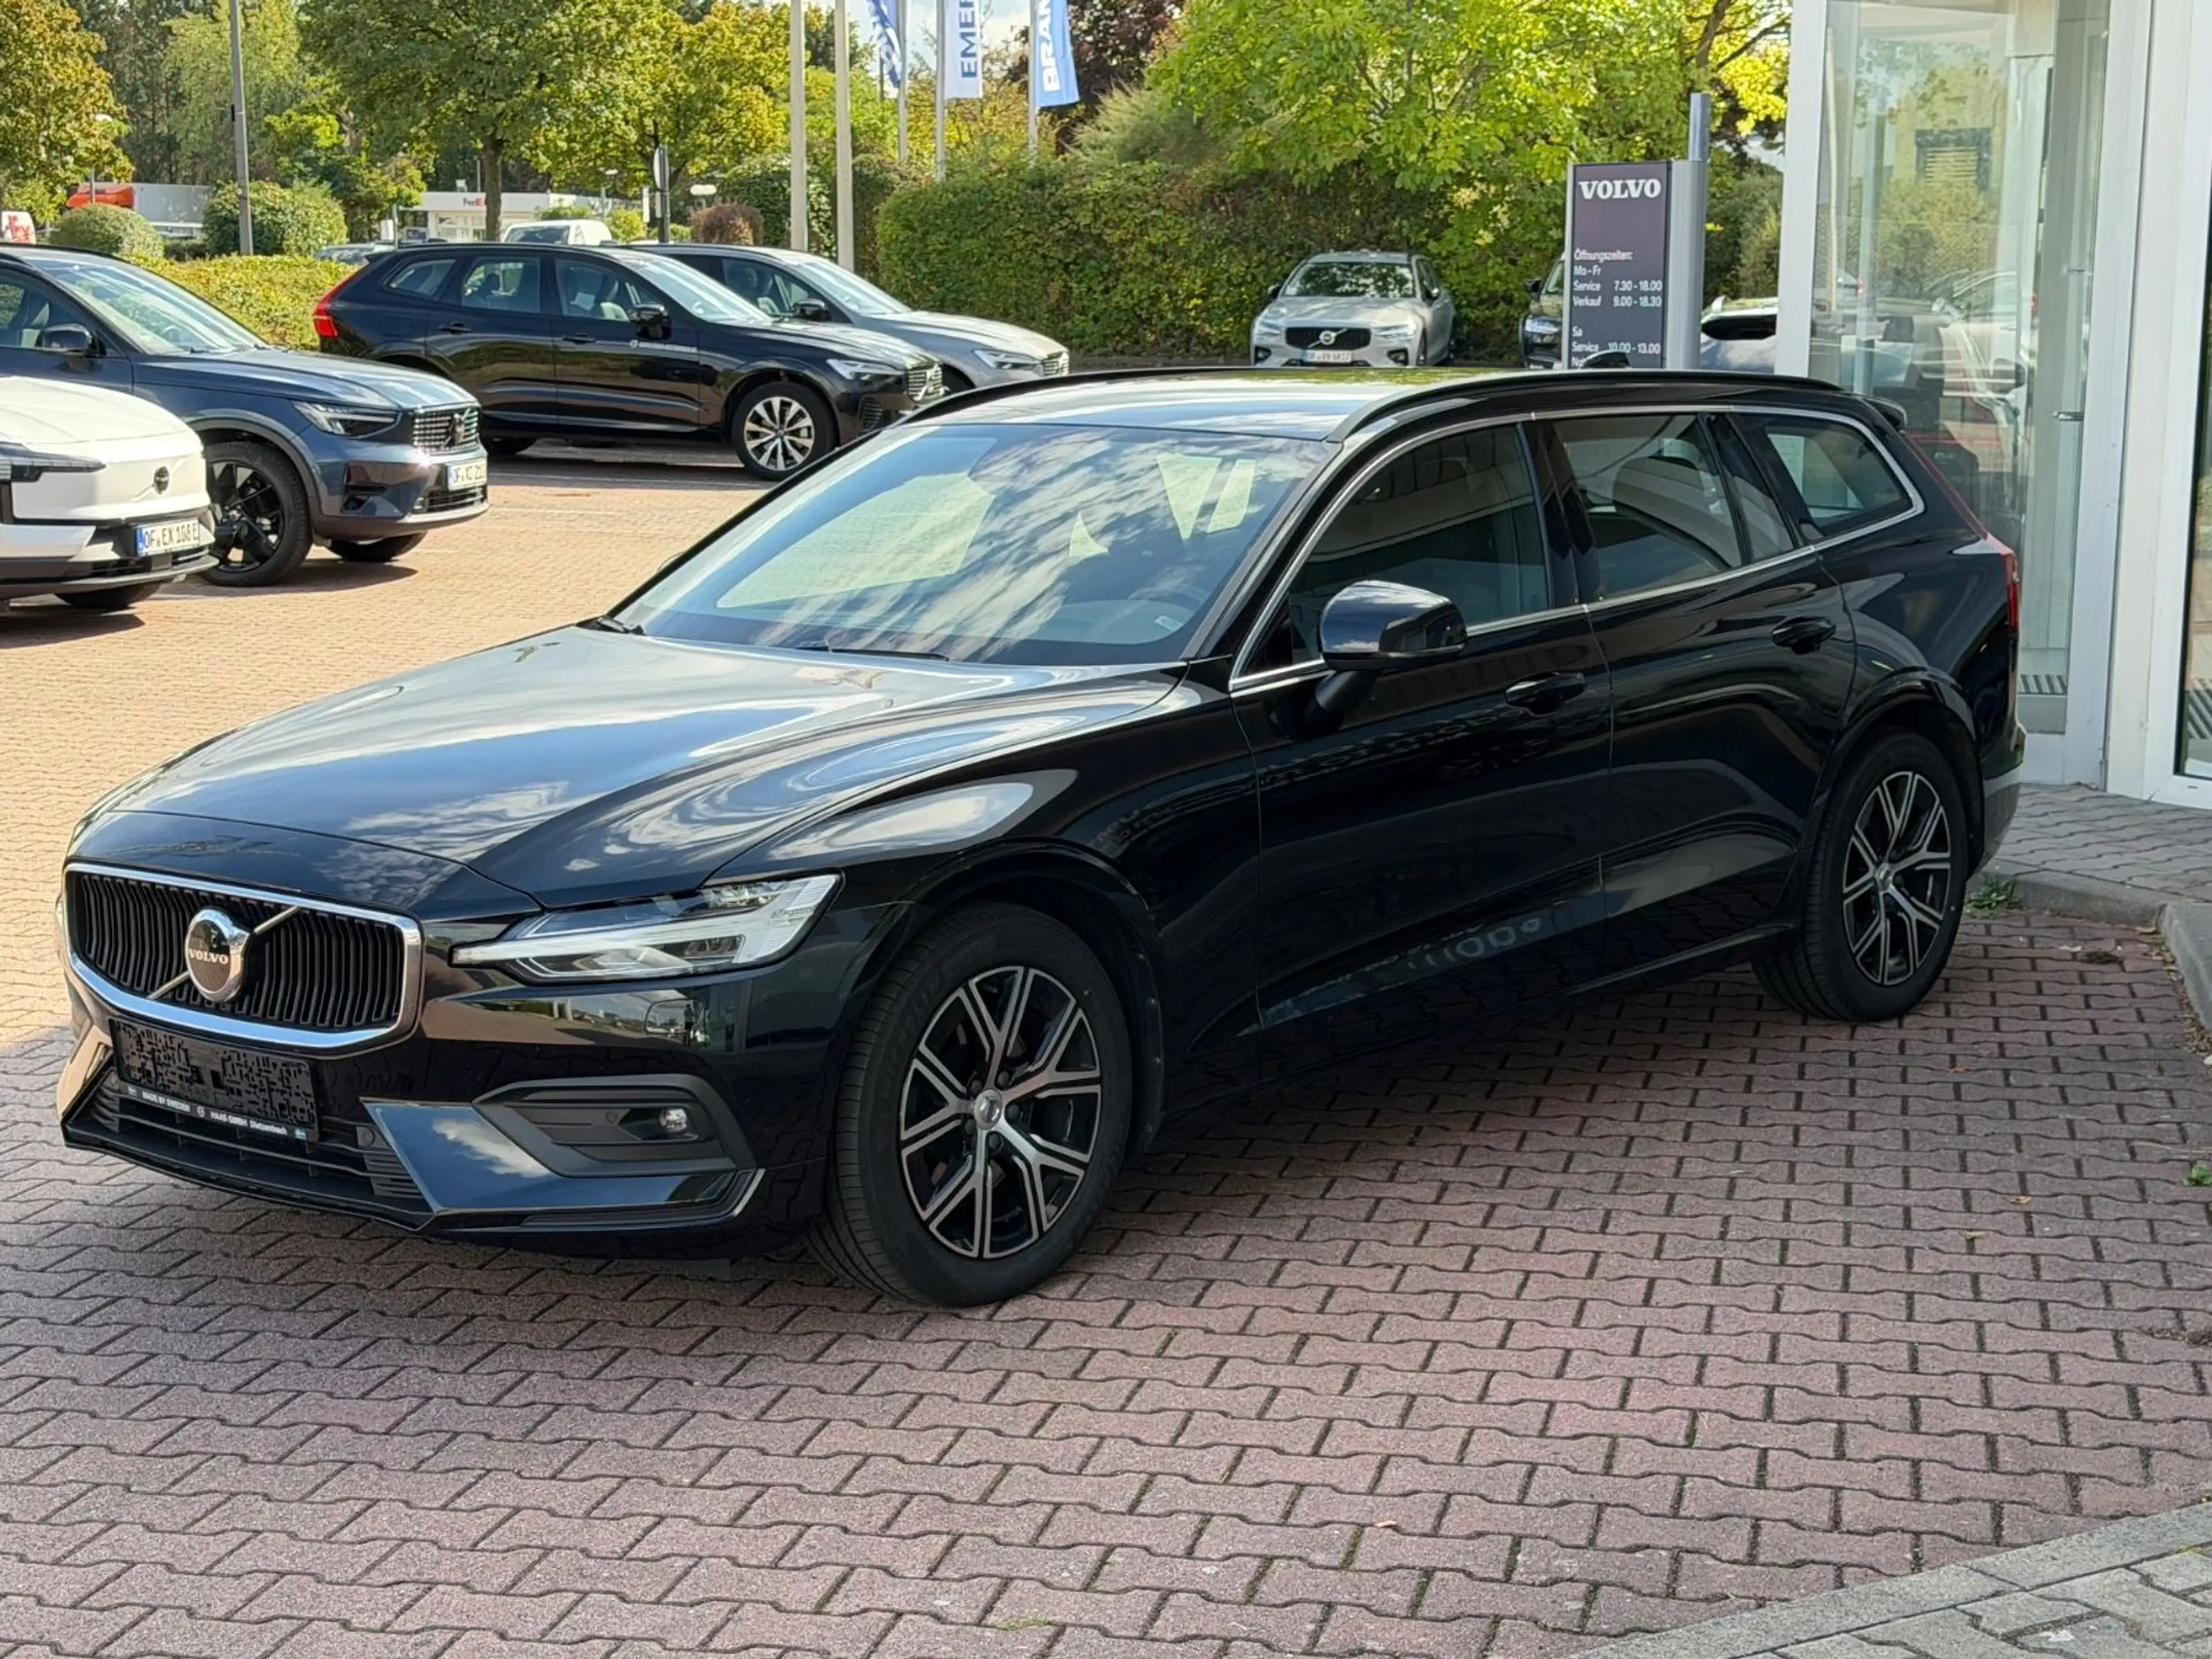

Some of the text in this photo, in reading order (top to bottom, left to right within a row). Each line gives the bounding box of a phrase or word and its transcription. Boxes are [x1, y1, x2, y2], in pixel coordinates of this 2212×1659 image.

[1578, 179, 1661, 199] VOLVO
[1573, 279, 1601, 291] Service
[1614, 280, 1633, 291] 7.30
[1639, 280, 1662, 291] 18.00
[1573, 295, 1601, 306] Verkauf
[1613, 296, 1633, 307] 9.00
[1639, 296, 1662, 307] 18.30
[1572, 326, 1582, 336] Sa
[1571, 341, 1599, 352] Service
[1638, 343, 1661, 354] 13.00
[188, 948, 229, 964] VOLVO
